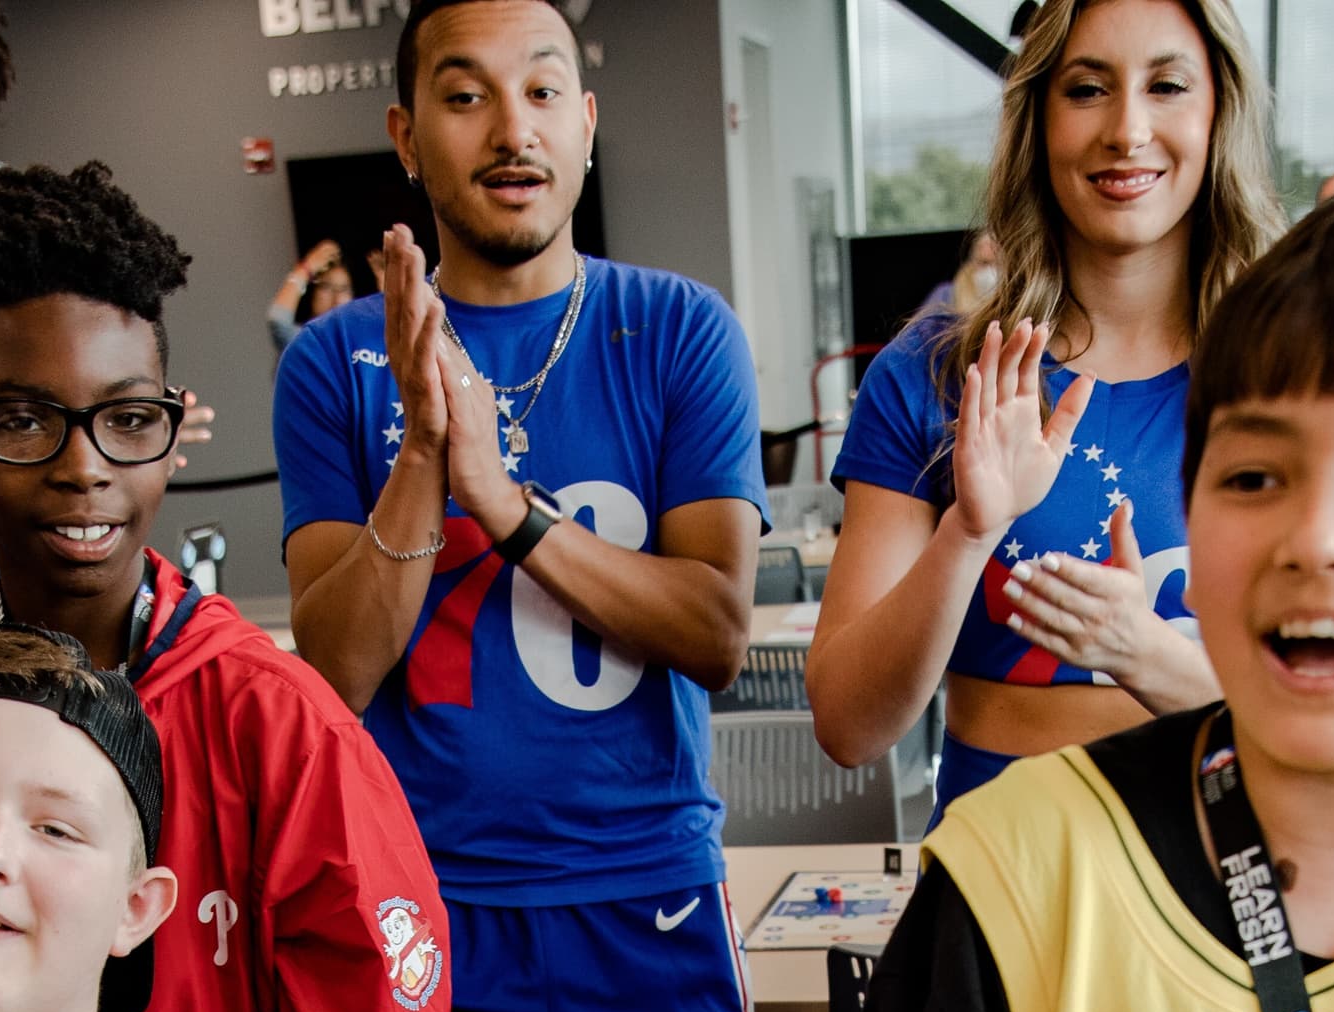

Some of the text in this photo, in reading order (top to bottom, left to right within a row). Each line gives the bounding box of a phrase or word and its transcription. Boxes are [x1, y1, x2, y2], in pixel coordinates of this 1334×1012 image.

[260, 0, 415, 37] BELF
[269, 62, 395, 97] PROPERT
[198, 890, 238, 966] P
[1220, 853, 1269, 967] FRESH
[1243, 846, 1292, 958] LEARN
